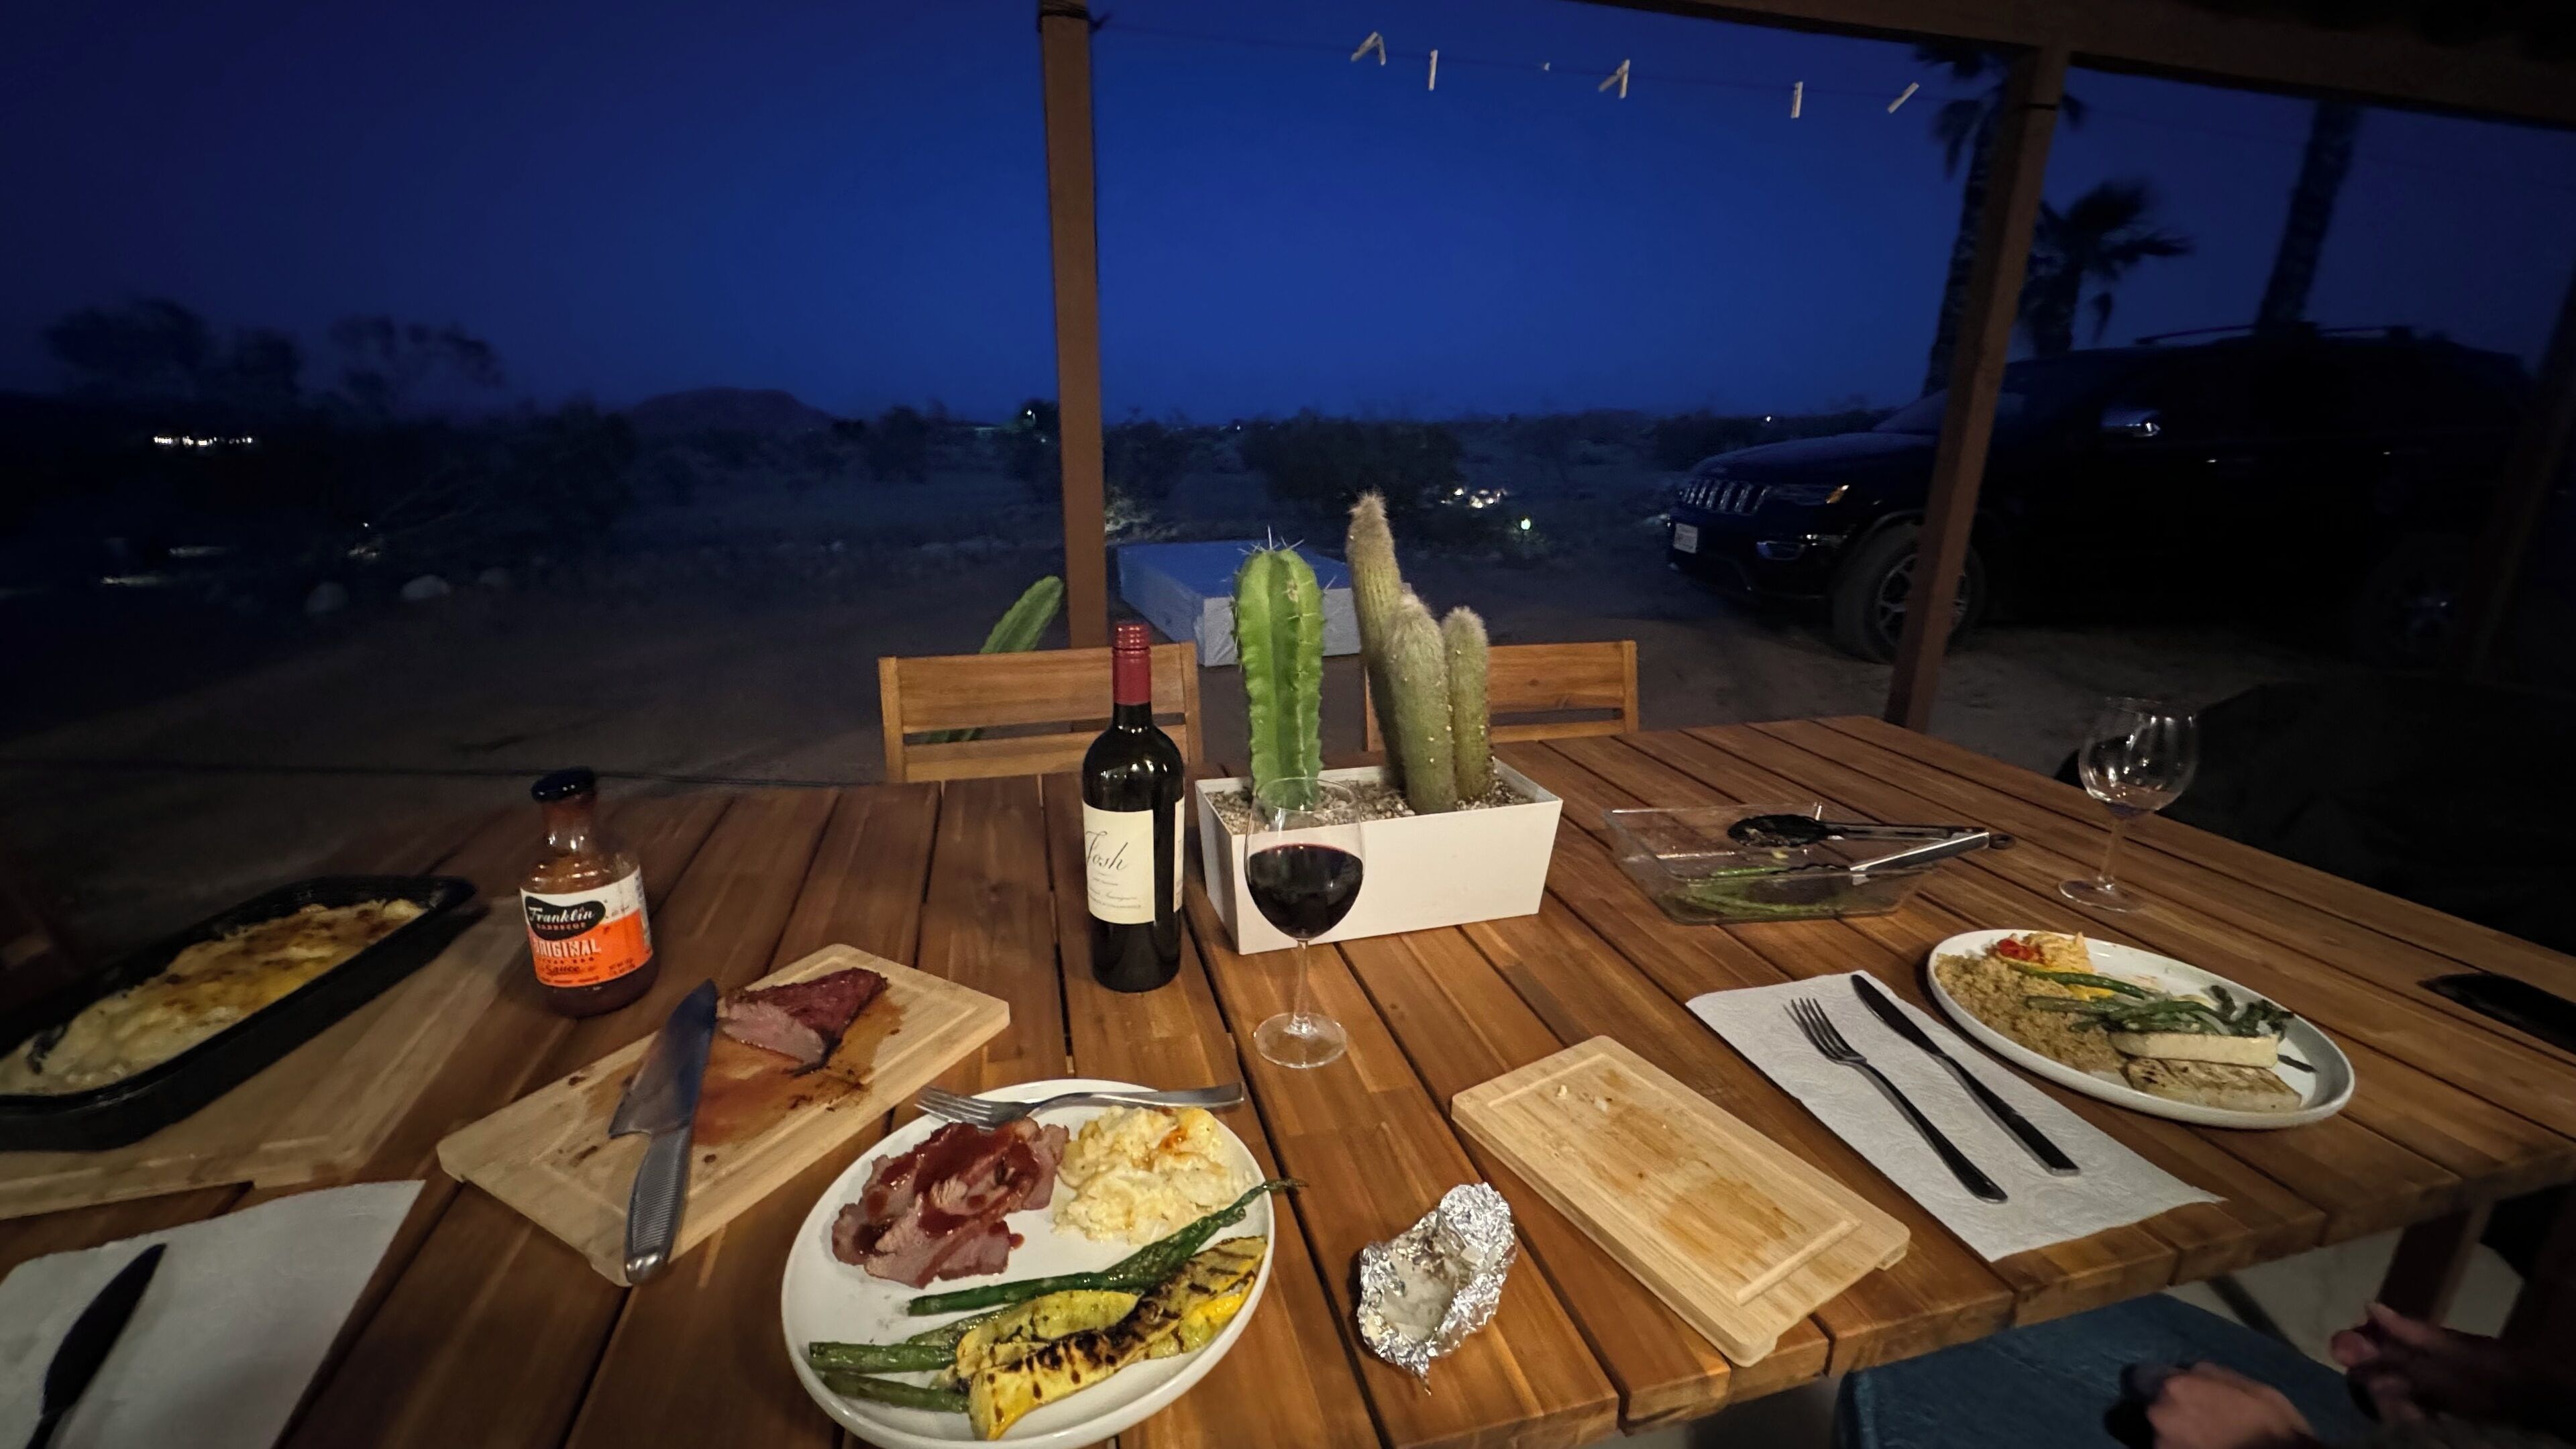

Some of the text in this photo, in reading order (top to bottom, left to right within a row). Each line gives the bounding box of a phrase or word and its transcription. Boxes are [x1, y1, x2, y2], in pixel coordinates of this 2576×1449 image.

[1085, 830, 1128, 870] Josh
[528, 906, 594, 923] Franklin
[533, 938, 602, 957] ORIGINAL
